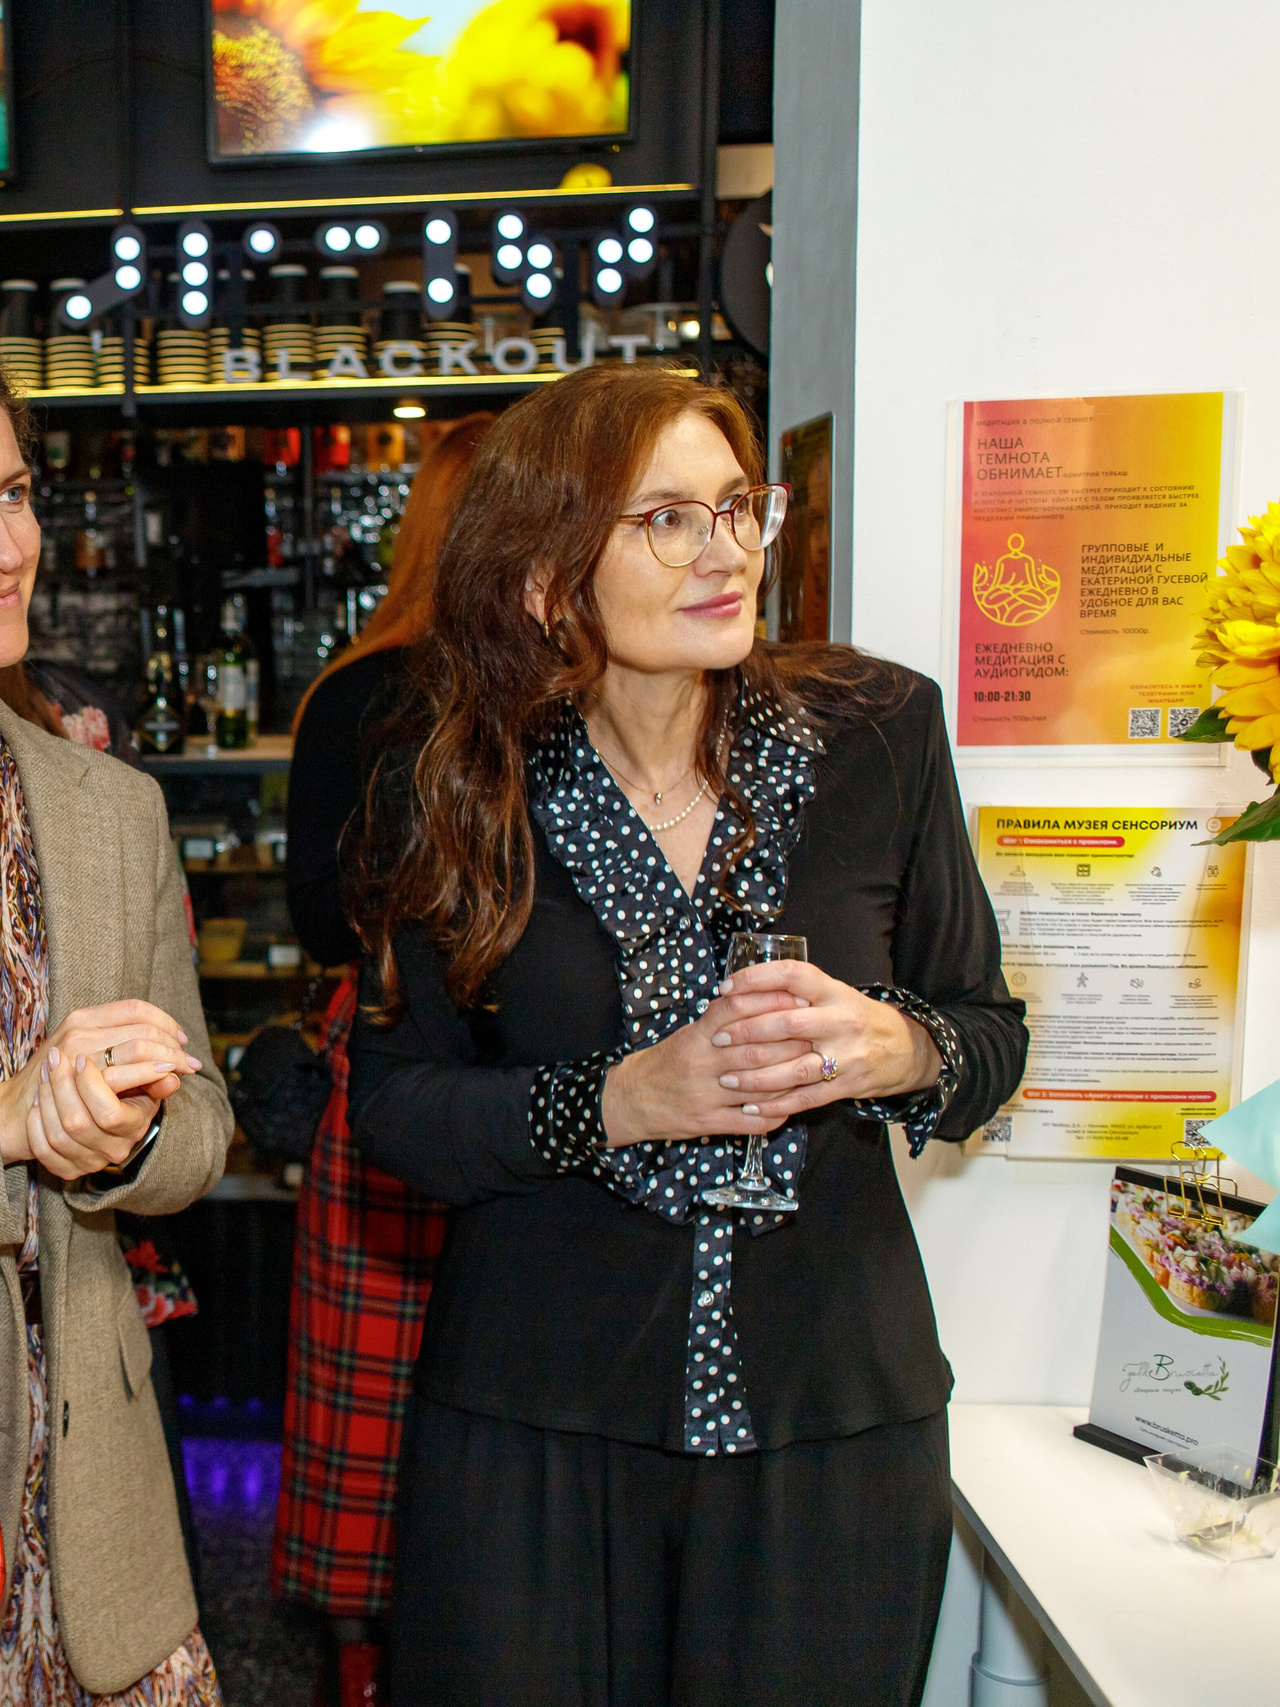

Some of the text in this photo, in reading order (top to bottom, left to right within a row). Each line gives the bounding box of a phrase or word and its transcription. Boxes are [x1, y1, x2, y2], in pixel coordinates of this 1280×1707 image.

[223, 333, 651, 385] BLACKOUT
[977, 437, 1024, 450] НАША
[977, 451, 1050, 465] ТЕМНОТА
[977, 466, 1063, 481] ОБНИМАЕТ
[1103, 486, 1141, 494] ПРИХОДИТ
[1081, 543, 1164, 553] ГРУППОВЫЕ И
[1081, 553, 1192, 565] ИНДИВИДУАЛЬНЫЕ
[1081, 564, 1163, 576] МЕДИТАЦИИ С
[1080, 572, 1208, 586] ЕКАТЕРИНОЙ ГУСЕВОЙ
[1080, 586, 1159, 597] ЕЖЕДНЕВНО В
[1080, 597, 1184, 609] УДОБНОЕ ДЛЯ ВАС
[1080, 609, 1117, 619] ВРЕМЯ
[975, 642, 1053, 655] ЕЖЕДНЕВНО
[975, 654, 1066, 666] МЕДИТАЦИЯ С
[974, 667, 1069, 679] АУДИОГИДОМ:
[974, 690, 1031, 702] 10:00-21:30
[996, 819, 1198, 830] ПРАВИЛА МУЗЕЯ СЕНСОРИУМ
[1135, 1416, 1199, 1446] www.brusketta.pro
